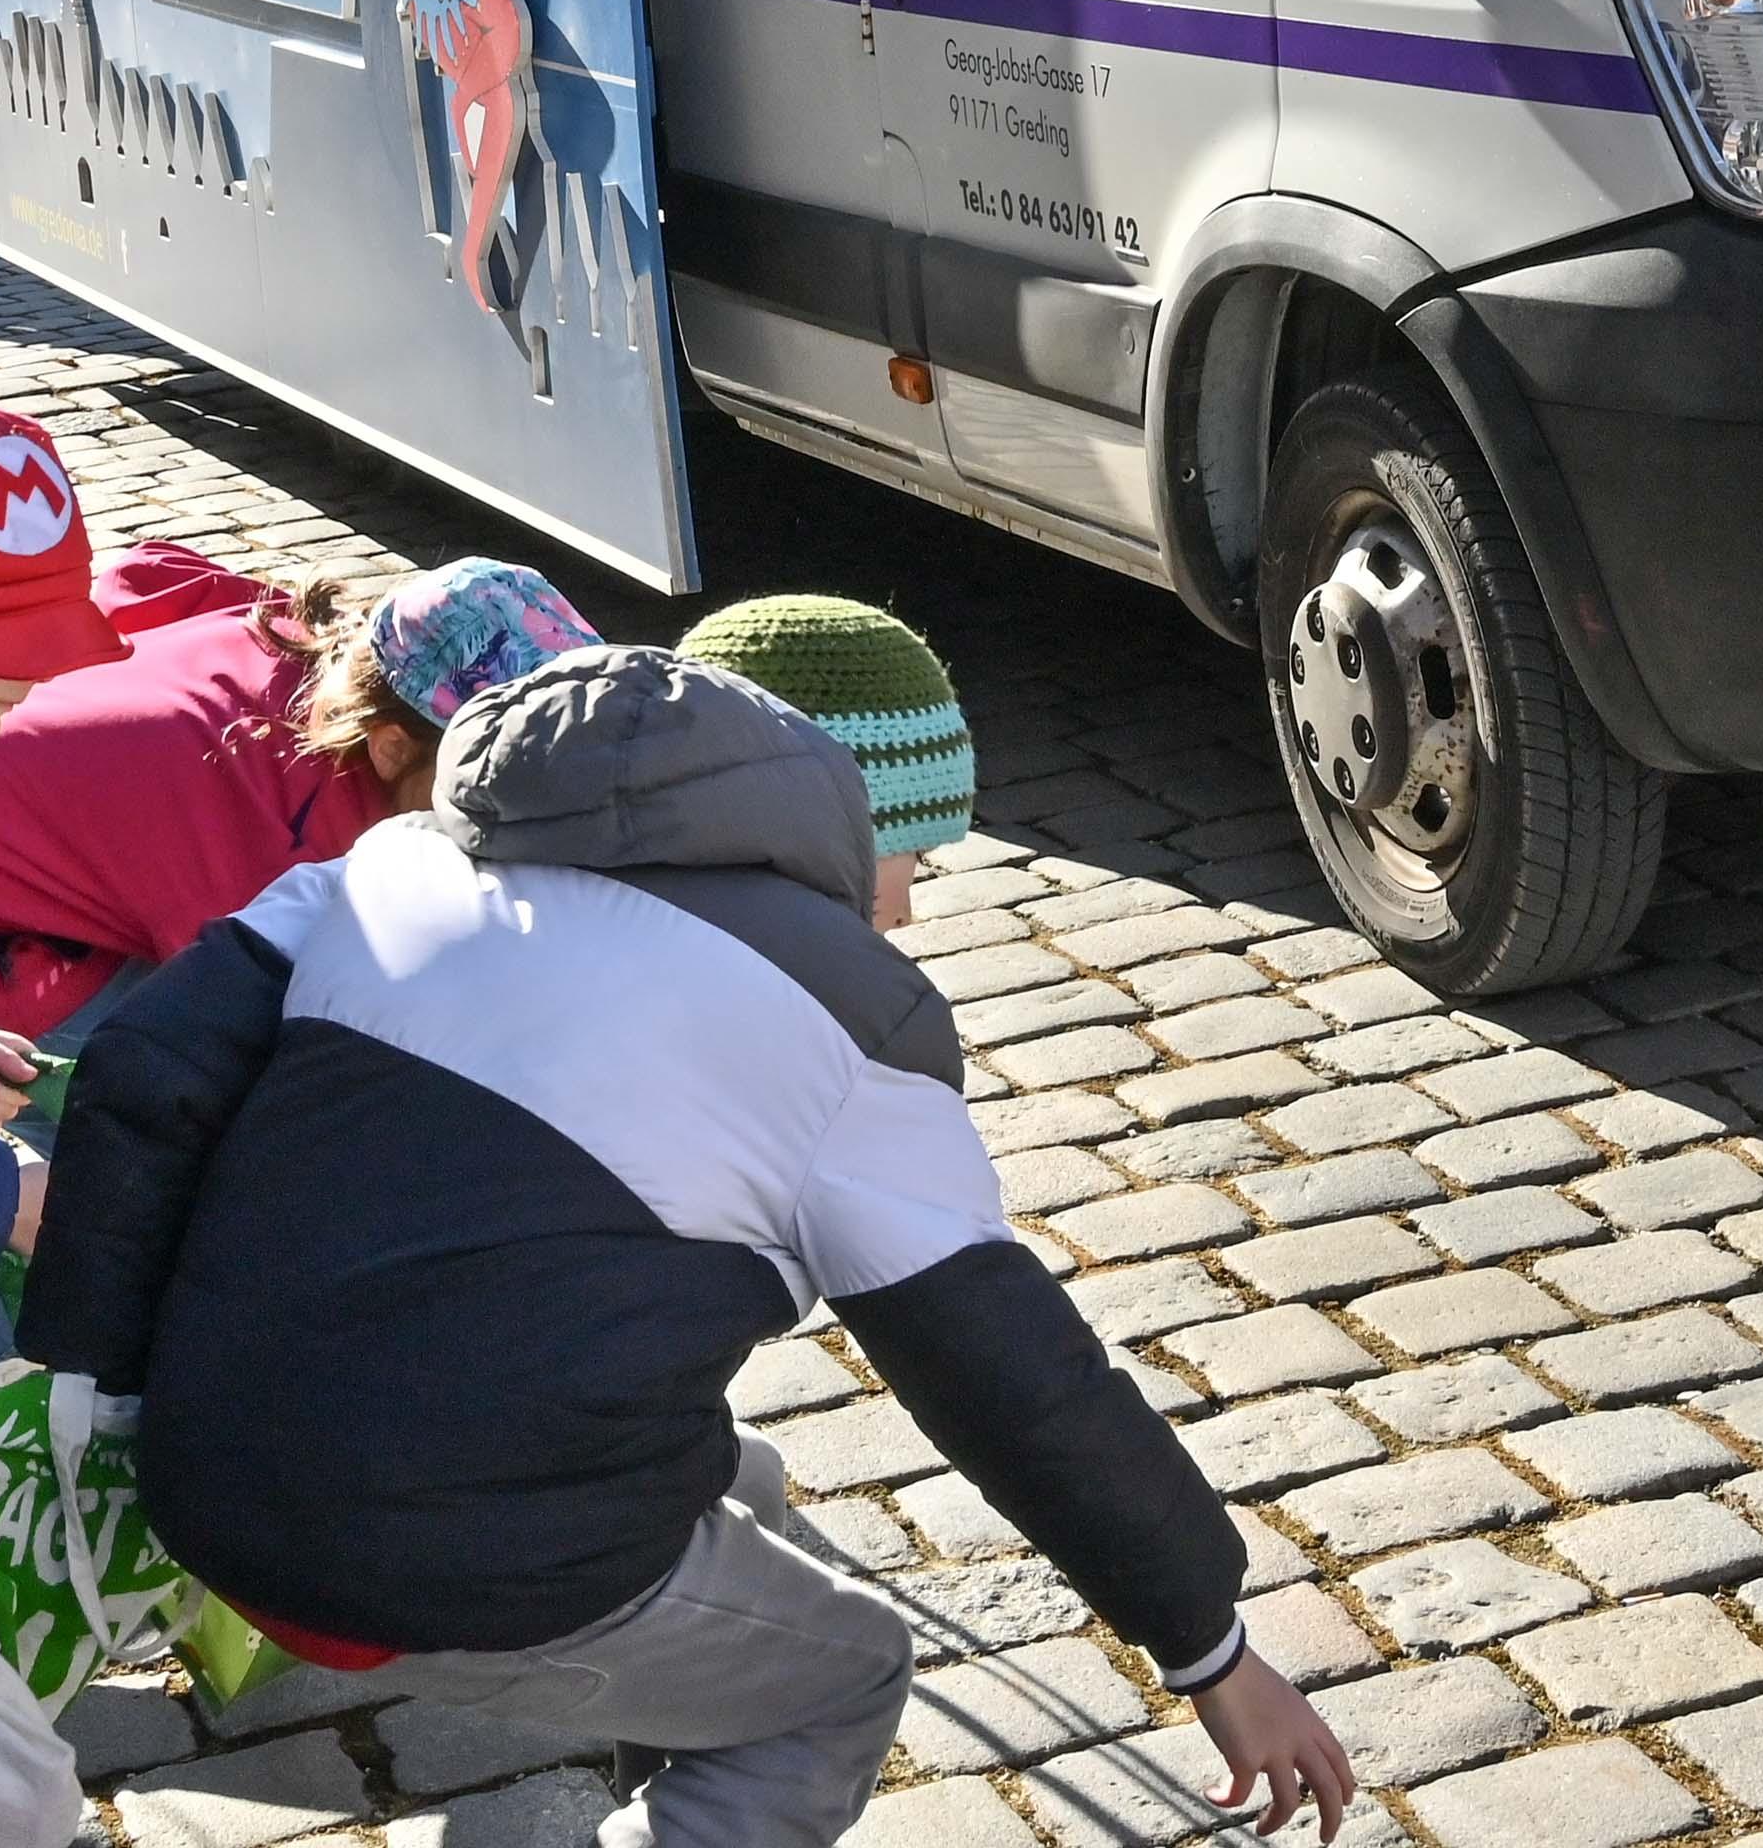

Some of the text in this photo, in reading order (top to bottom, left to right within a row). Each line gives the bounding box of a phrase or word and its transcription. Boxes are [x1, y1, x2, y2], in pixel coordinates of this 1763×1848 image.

[944, 38, 1112, 98] Georg-Jobst-Gasse 17
[949, 94, 1070, 157] 91171 Greding
[959, 178, 1140, 251] Tel.: 0 84 63/91 42
